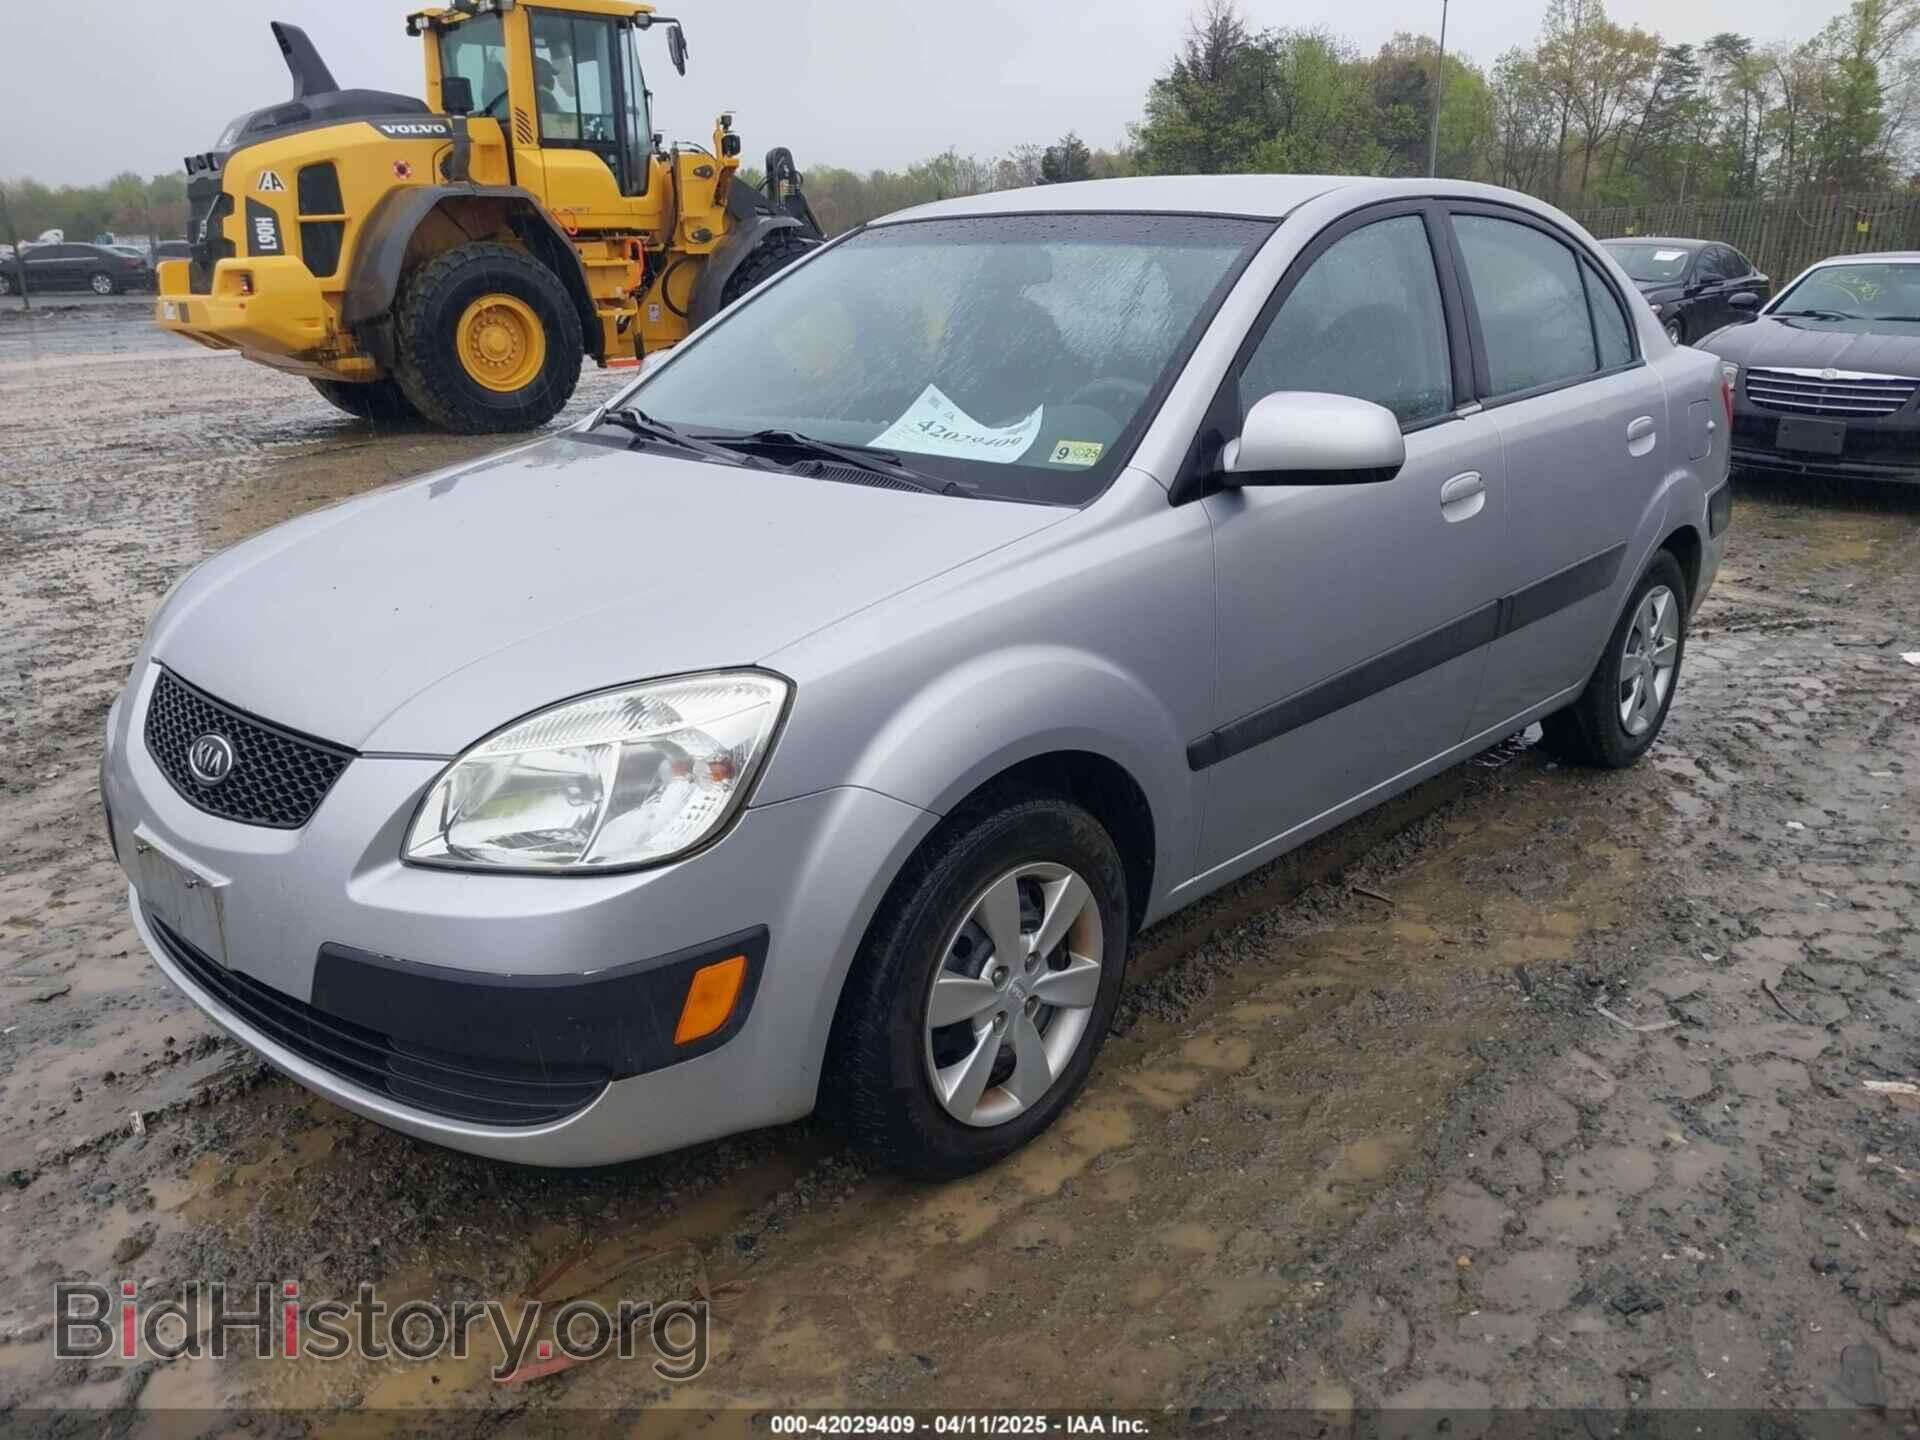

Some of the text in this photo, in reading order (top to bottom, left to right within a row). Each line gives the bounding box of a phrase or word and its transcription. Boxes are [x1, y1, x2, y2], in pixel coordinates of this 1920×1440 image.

[381, 124, 447, 134] VOLVO
[255, 217, 278, 250] L90H
[1056, 447, 1070, 460] 9
[194, 741, 223, 775] KIA
